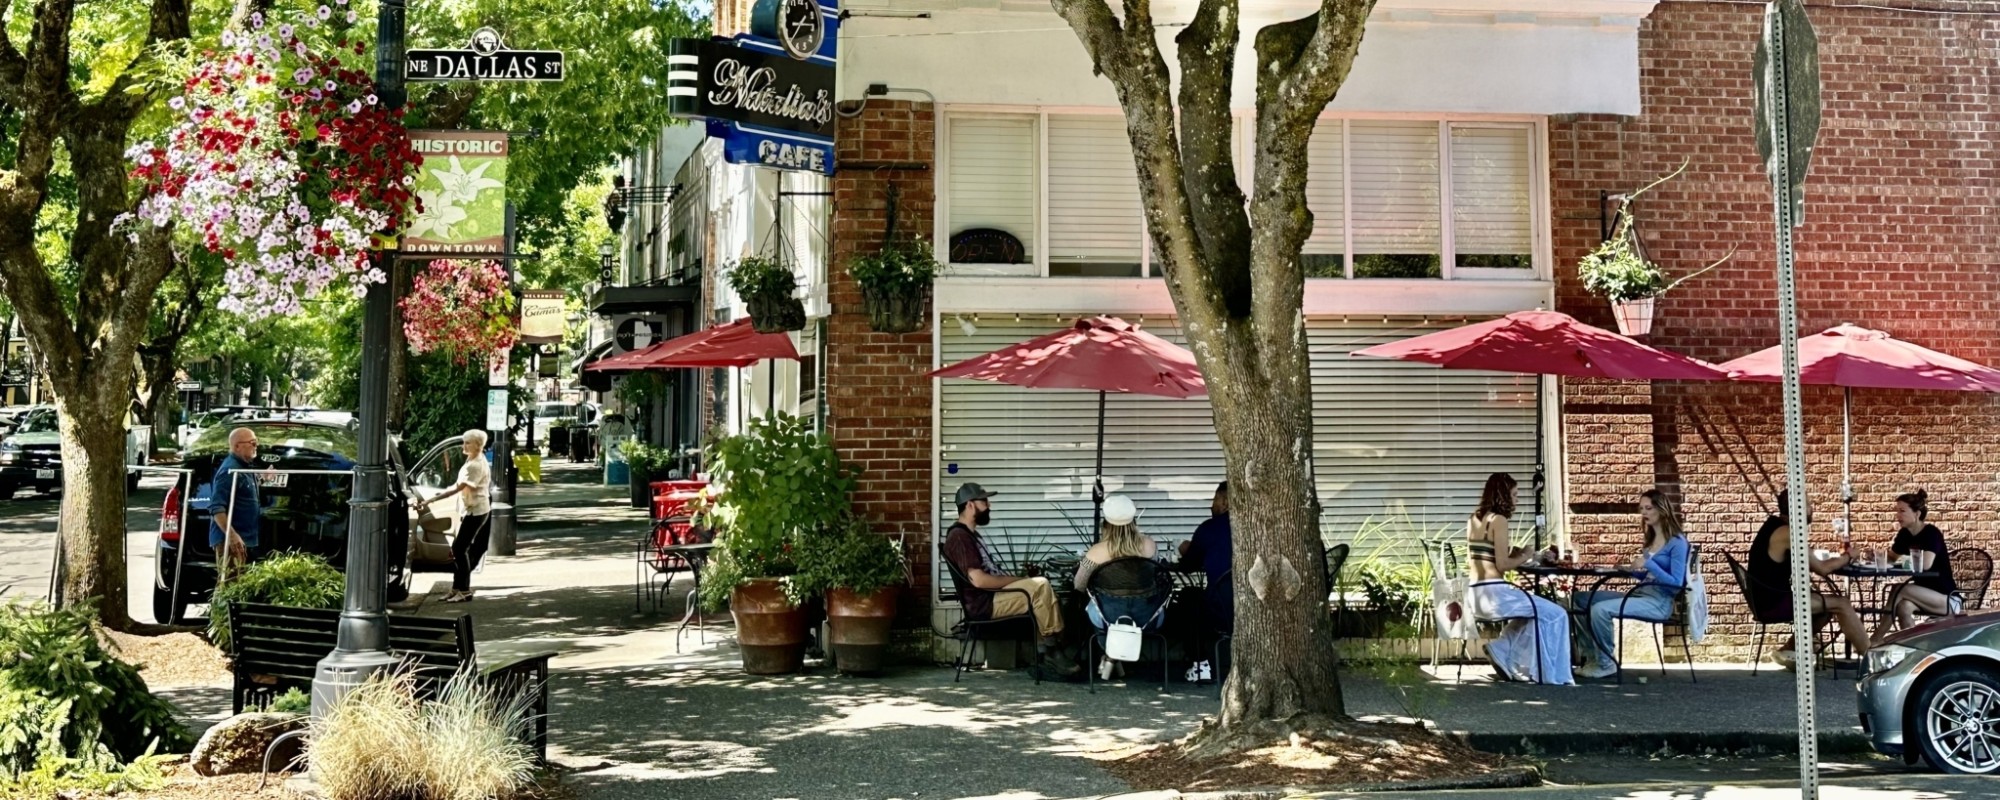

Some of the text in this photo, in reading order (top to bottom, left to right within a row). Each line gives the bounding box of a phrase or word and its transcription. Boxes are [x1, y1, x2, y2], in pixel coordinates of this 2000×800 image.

[409, 55, 560, 78] NE DALLAS ST
[411, 139, 503, 153] HISTORIC
[758, 139, 825, 171] CAFE
[406, 243, 497, 253] DOWNTOWN
[951, 242, 1017, 262] OPEN
[524, 304, 561, 318] Camas
